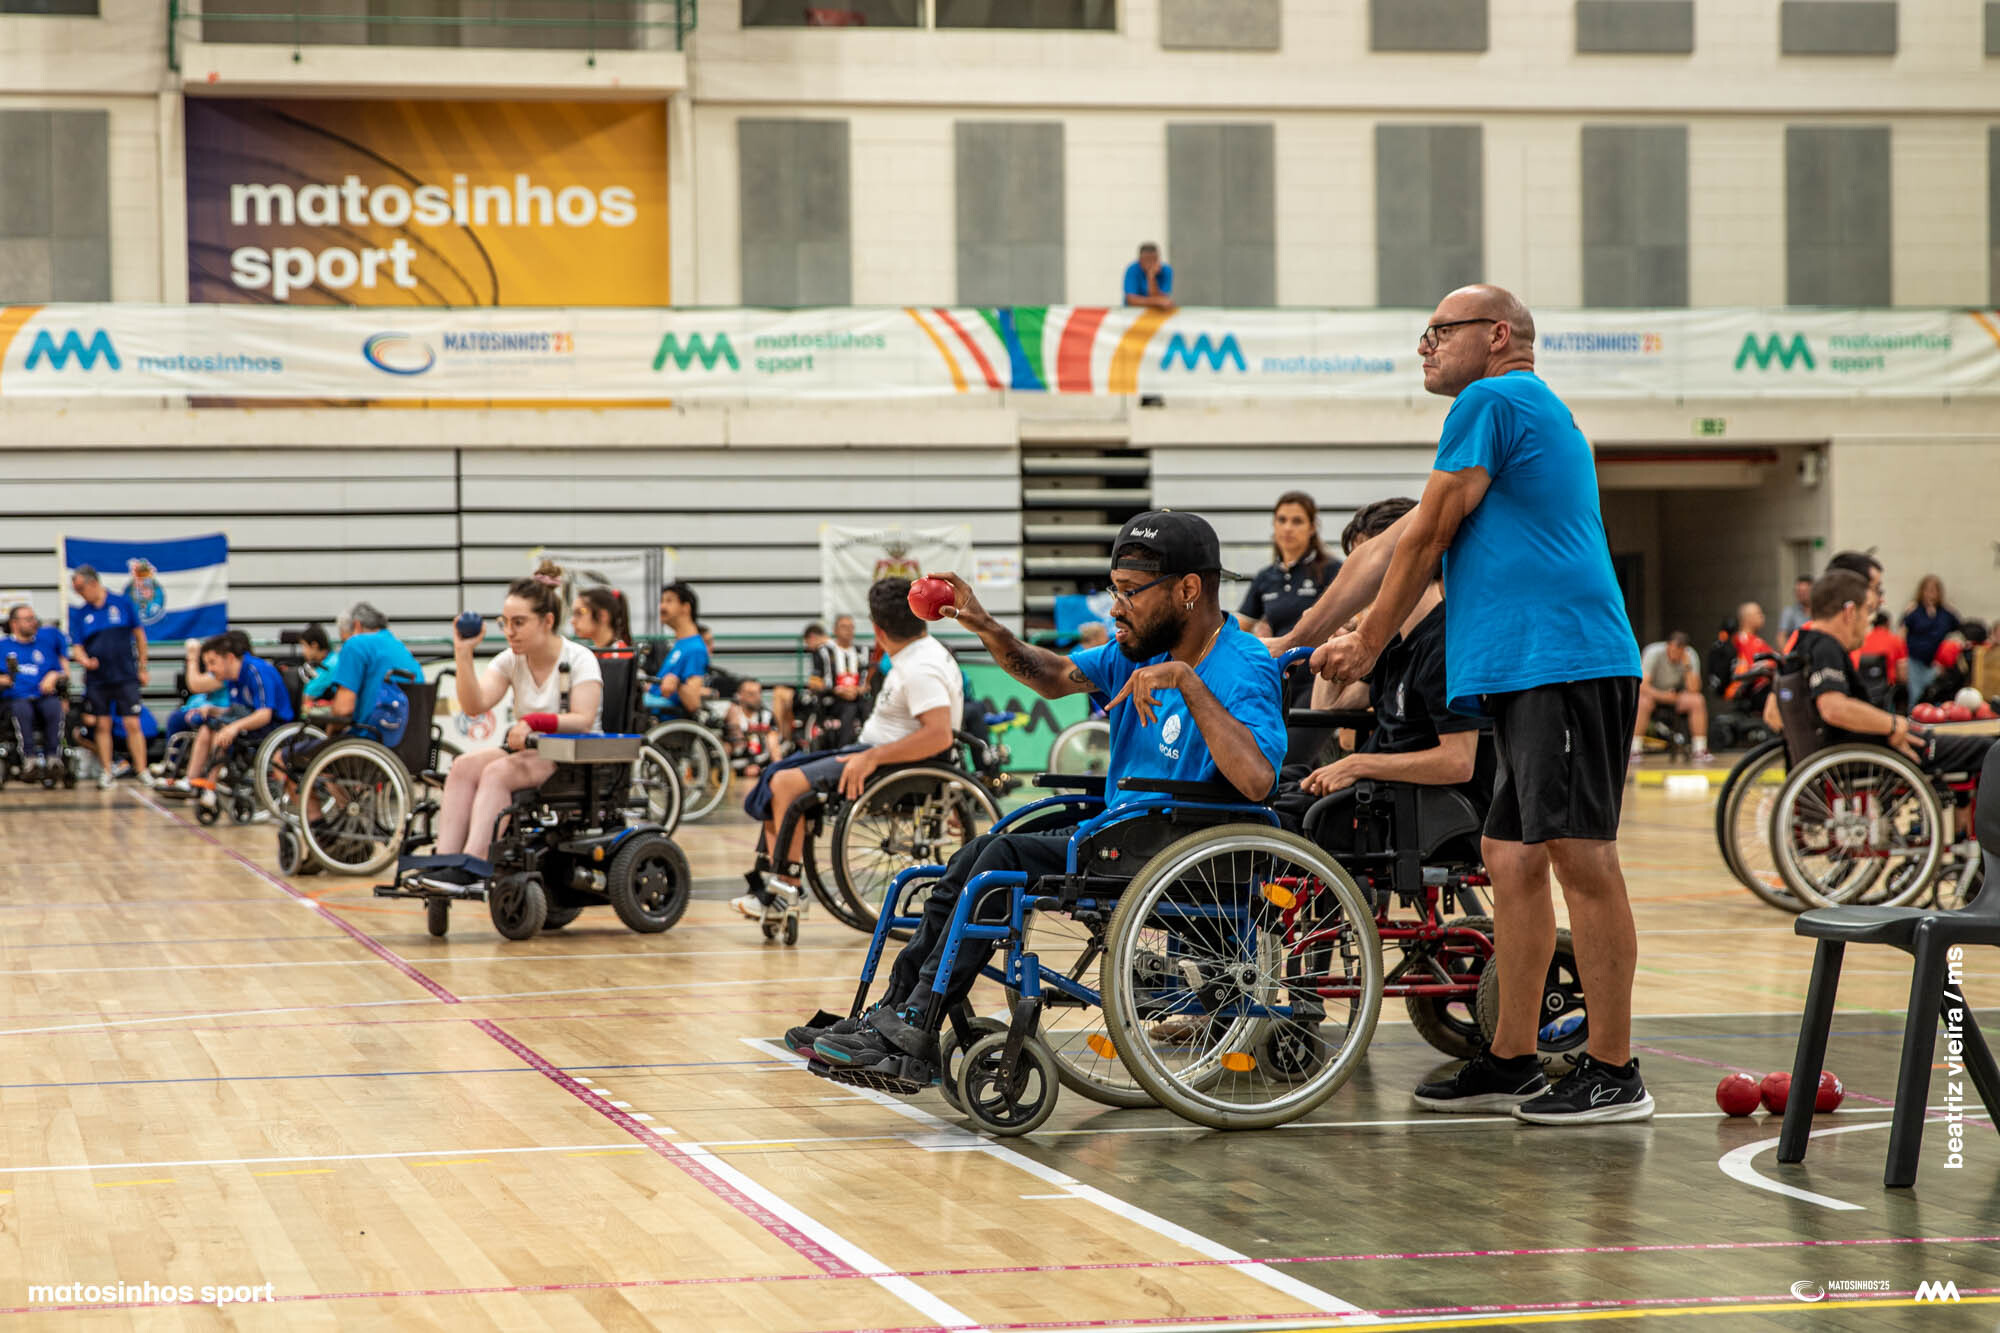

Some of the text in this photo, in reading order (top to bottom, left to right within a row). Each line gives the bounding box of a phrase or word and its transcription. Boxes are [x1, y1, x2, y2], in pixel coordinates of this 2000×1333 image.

[231, 175, 637, 227] matosinhos
[231, 240, 416, 299] sport
[754, 331, 886, 350] matosinhos
[137, 352, 283, 373] matosinhos
[754, 355, 814, 374] sport
[1829, 355, 1885, 375] sport
[1130, 527, 1159, 539] New York
